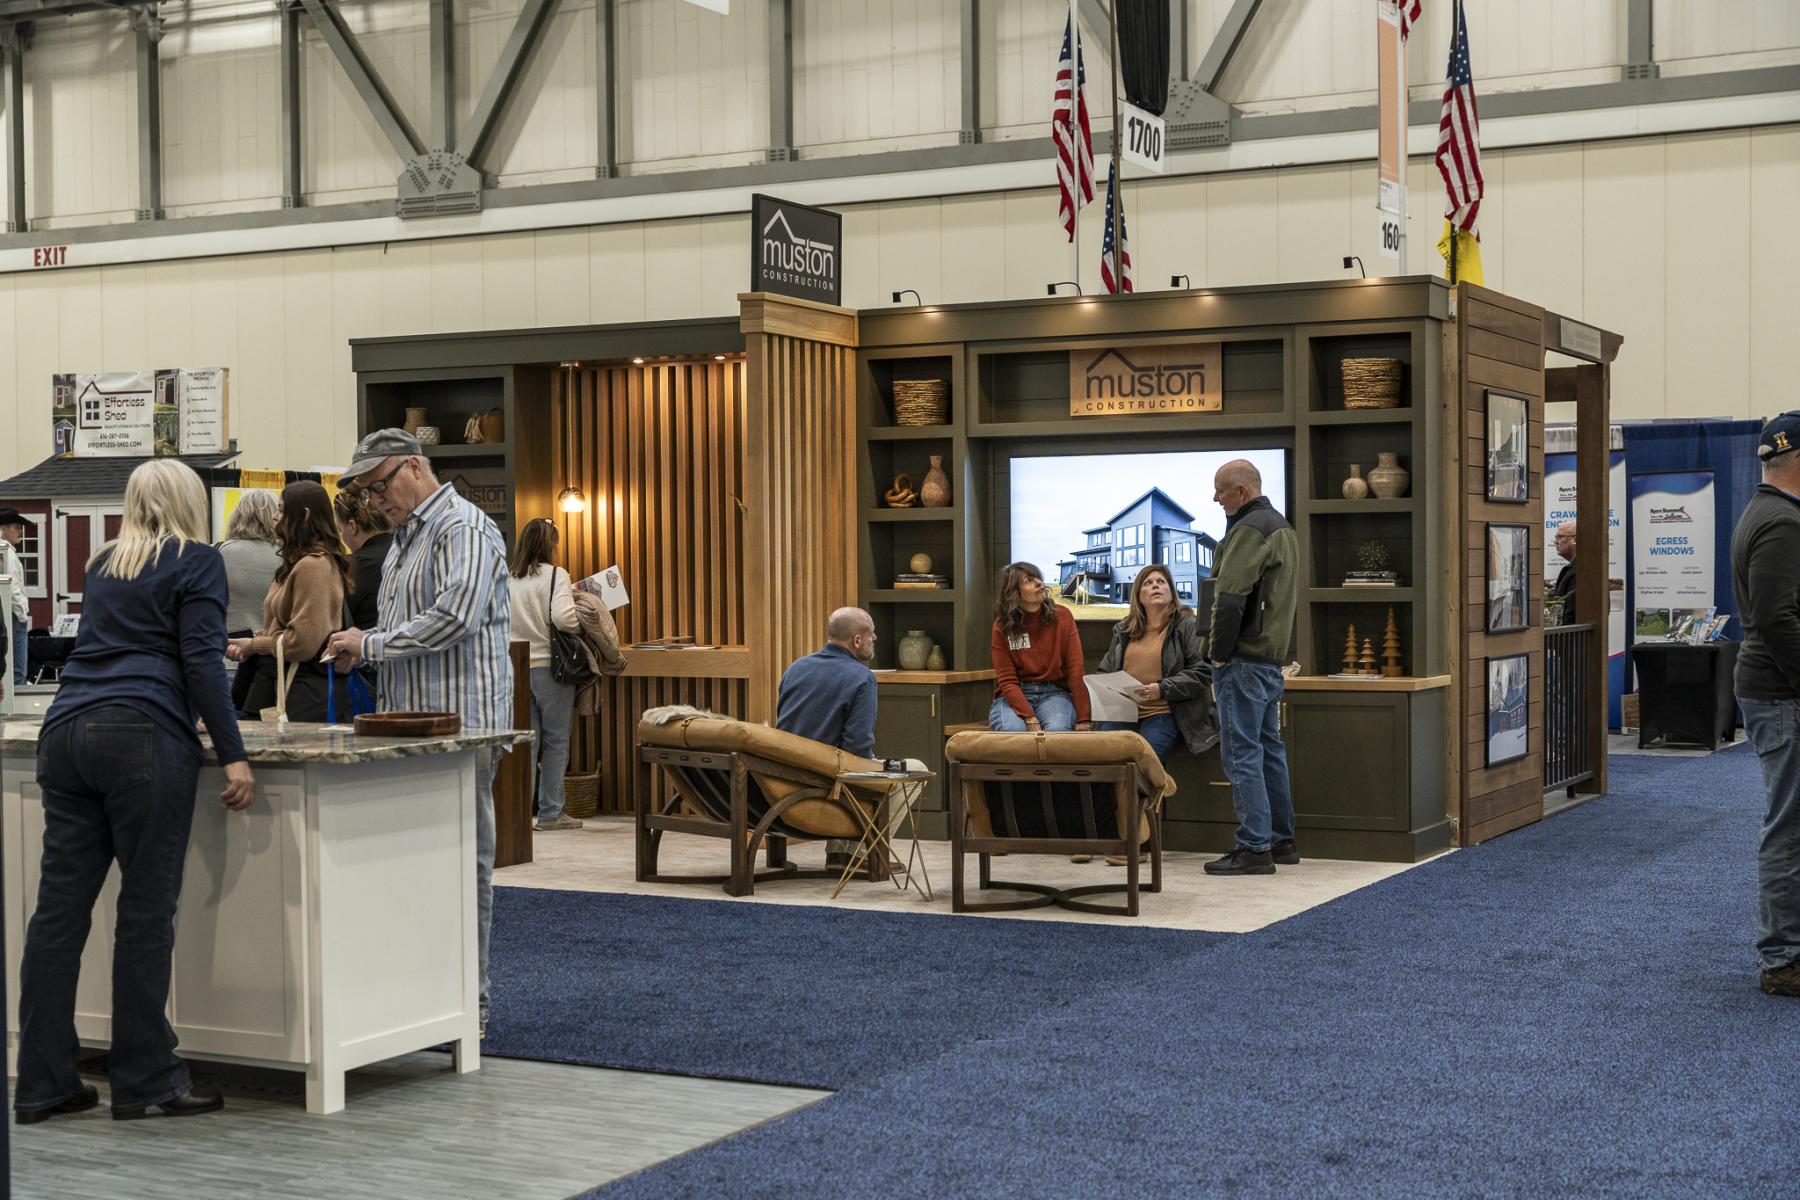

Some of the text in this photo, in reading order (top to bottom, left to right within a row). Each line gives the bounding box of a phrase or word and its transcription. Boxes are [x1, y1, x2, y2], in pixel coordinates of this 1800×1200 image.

[1128, 116, 1161, 162] 1700
[1382, 221, 1400, 251] 160
[34, 246, 67, 267] EXIT
[763, 238, 834, 279] muston
[763, 268, 834, 291] CONSTRUCTION
[1086, 364, 1205, 399] muston
[105, 396, 145, 408] Effortless
[1086, 398, 1205, 411] CONSTRUCTION
[105, 411, 127, 421] Shed
[459, 487, 506, 503] uston
[1550, 511, 1577, 519] CRAW
[1656, 537, 1688, 545] EGRESS
[1650, 547, 1694, 555] WINDOWS
